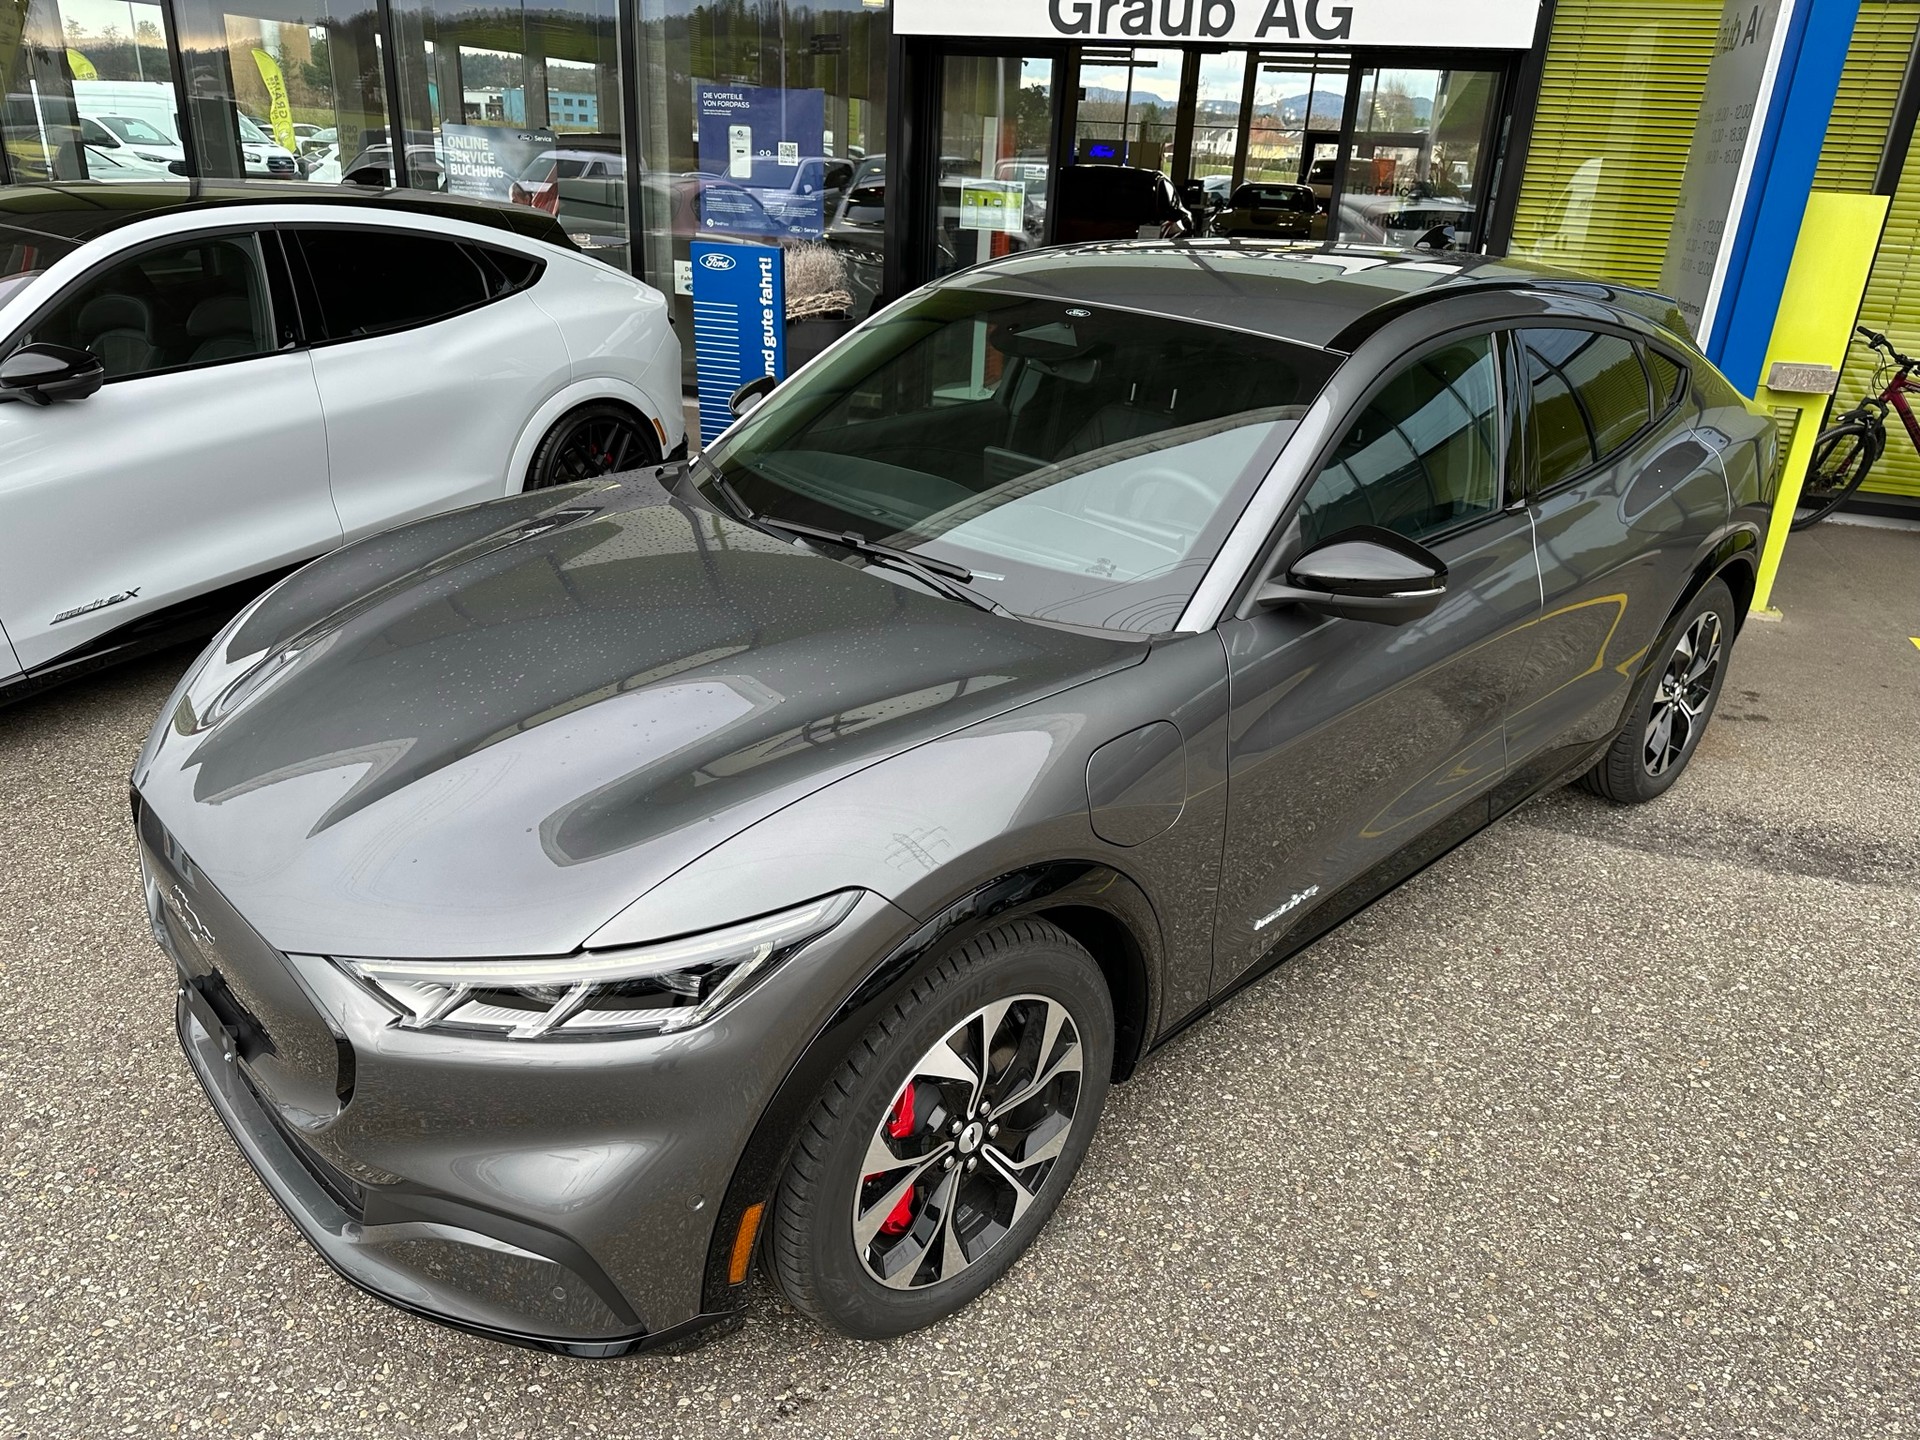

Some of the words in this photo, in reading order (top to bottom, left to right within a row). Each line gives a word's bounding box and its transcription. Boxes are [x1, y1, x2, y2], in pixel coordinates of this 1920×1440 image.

[1254, 0, 1354, 41] AG
[713, 92, 743, 100] VORTEILE
[717, 100, 750, 108] FORDPASS
[447, 136, 489, 150] ONLINE
[449, 151, 495, 164] SERVICE
[450, 164, 504, 178] BUCHUNG
[1353, 182, 1417, 197] Herzlic
[703, 254, 732, 269] Ford
[758, 257, 774, 305] fahrt!
[760, 308, 777, 348] gute
